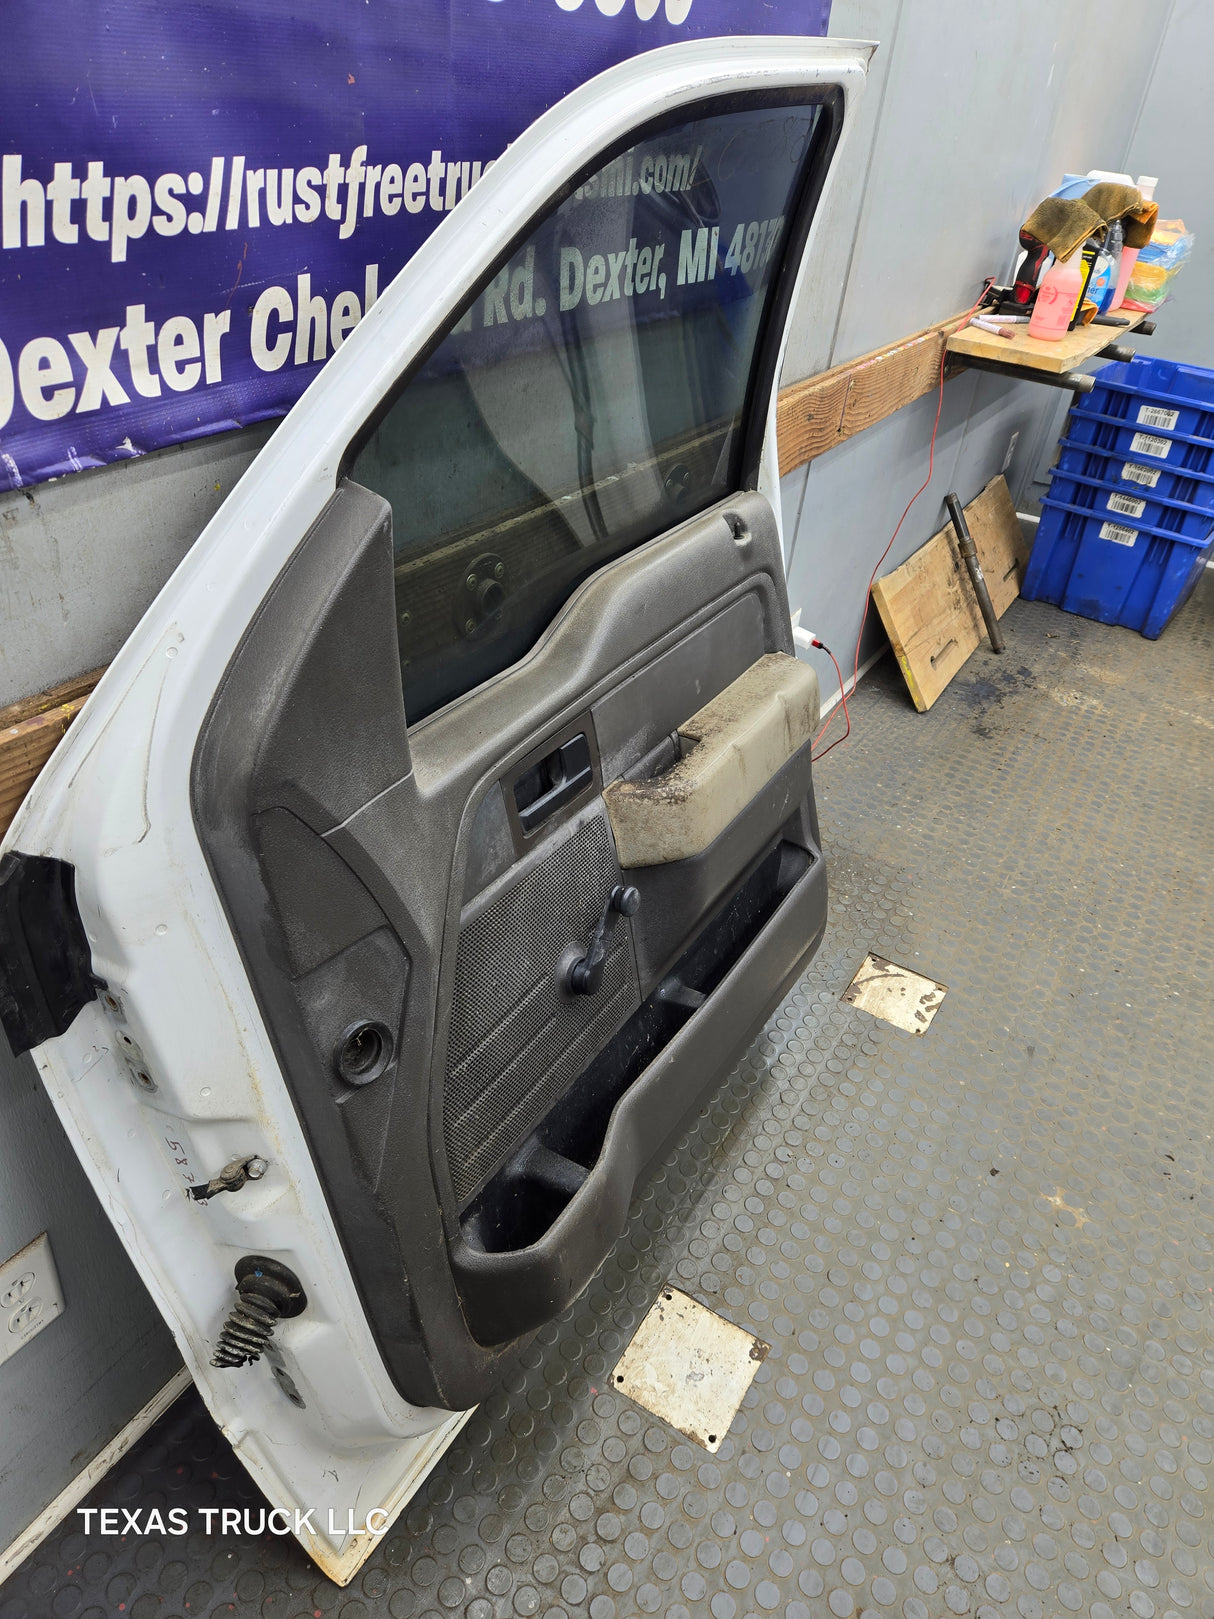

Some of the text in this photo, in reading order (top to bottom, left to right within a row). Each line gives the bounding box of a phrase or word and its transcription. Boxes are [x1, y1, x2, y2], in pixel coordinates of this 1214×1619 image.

[2, 145, 499, 262] https://rustfreetru
[0, 304, 230, 430] exter
[250, 264, 379, 372] Chel
[560, 237, 667, 312] Dexter,
[677, 226, 720, 286] MI
